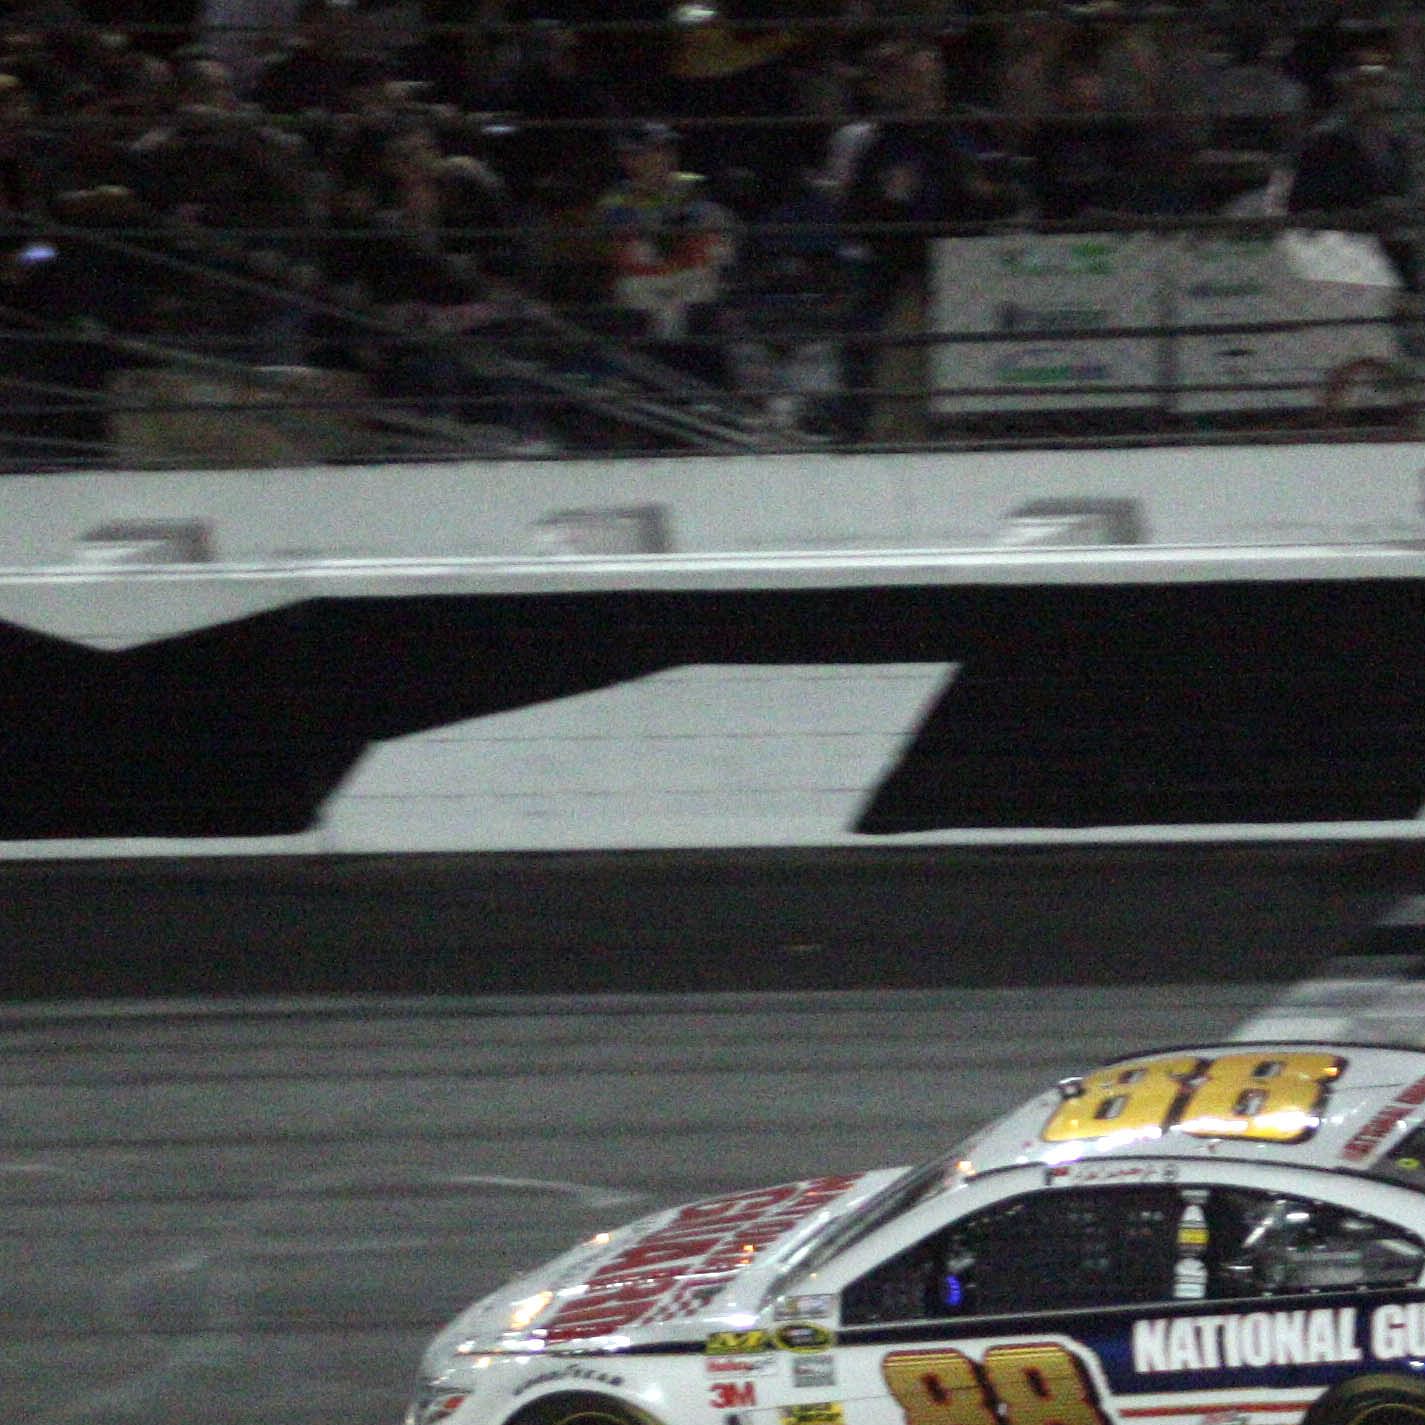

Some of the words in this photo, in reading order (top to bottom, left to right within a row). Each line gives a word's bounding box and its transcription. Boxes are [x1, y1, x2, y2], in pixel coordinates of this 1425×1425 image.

[1042, 1052, 1348, 1144] 88
[1132, 1308, 1362, 1374] NATIONAL
[709, 1382, 757, 1408] 3M
